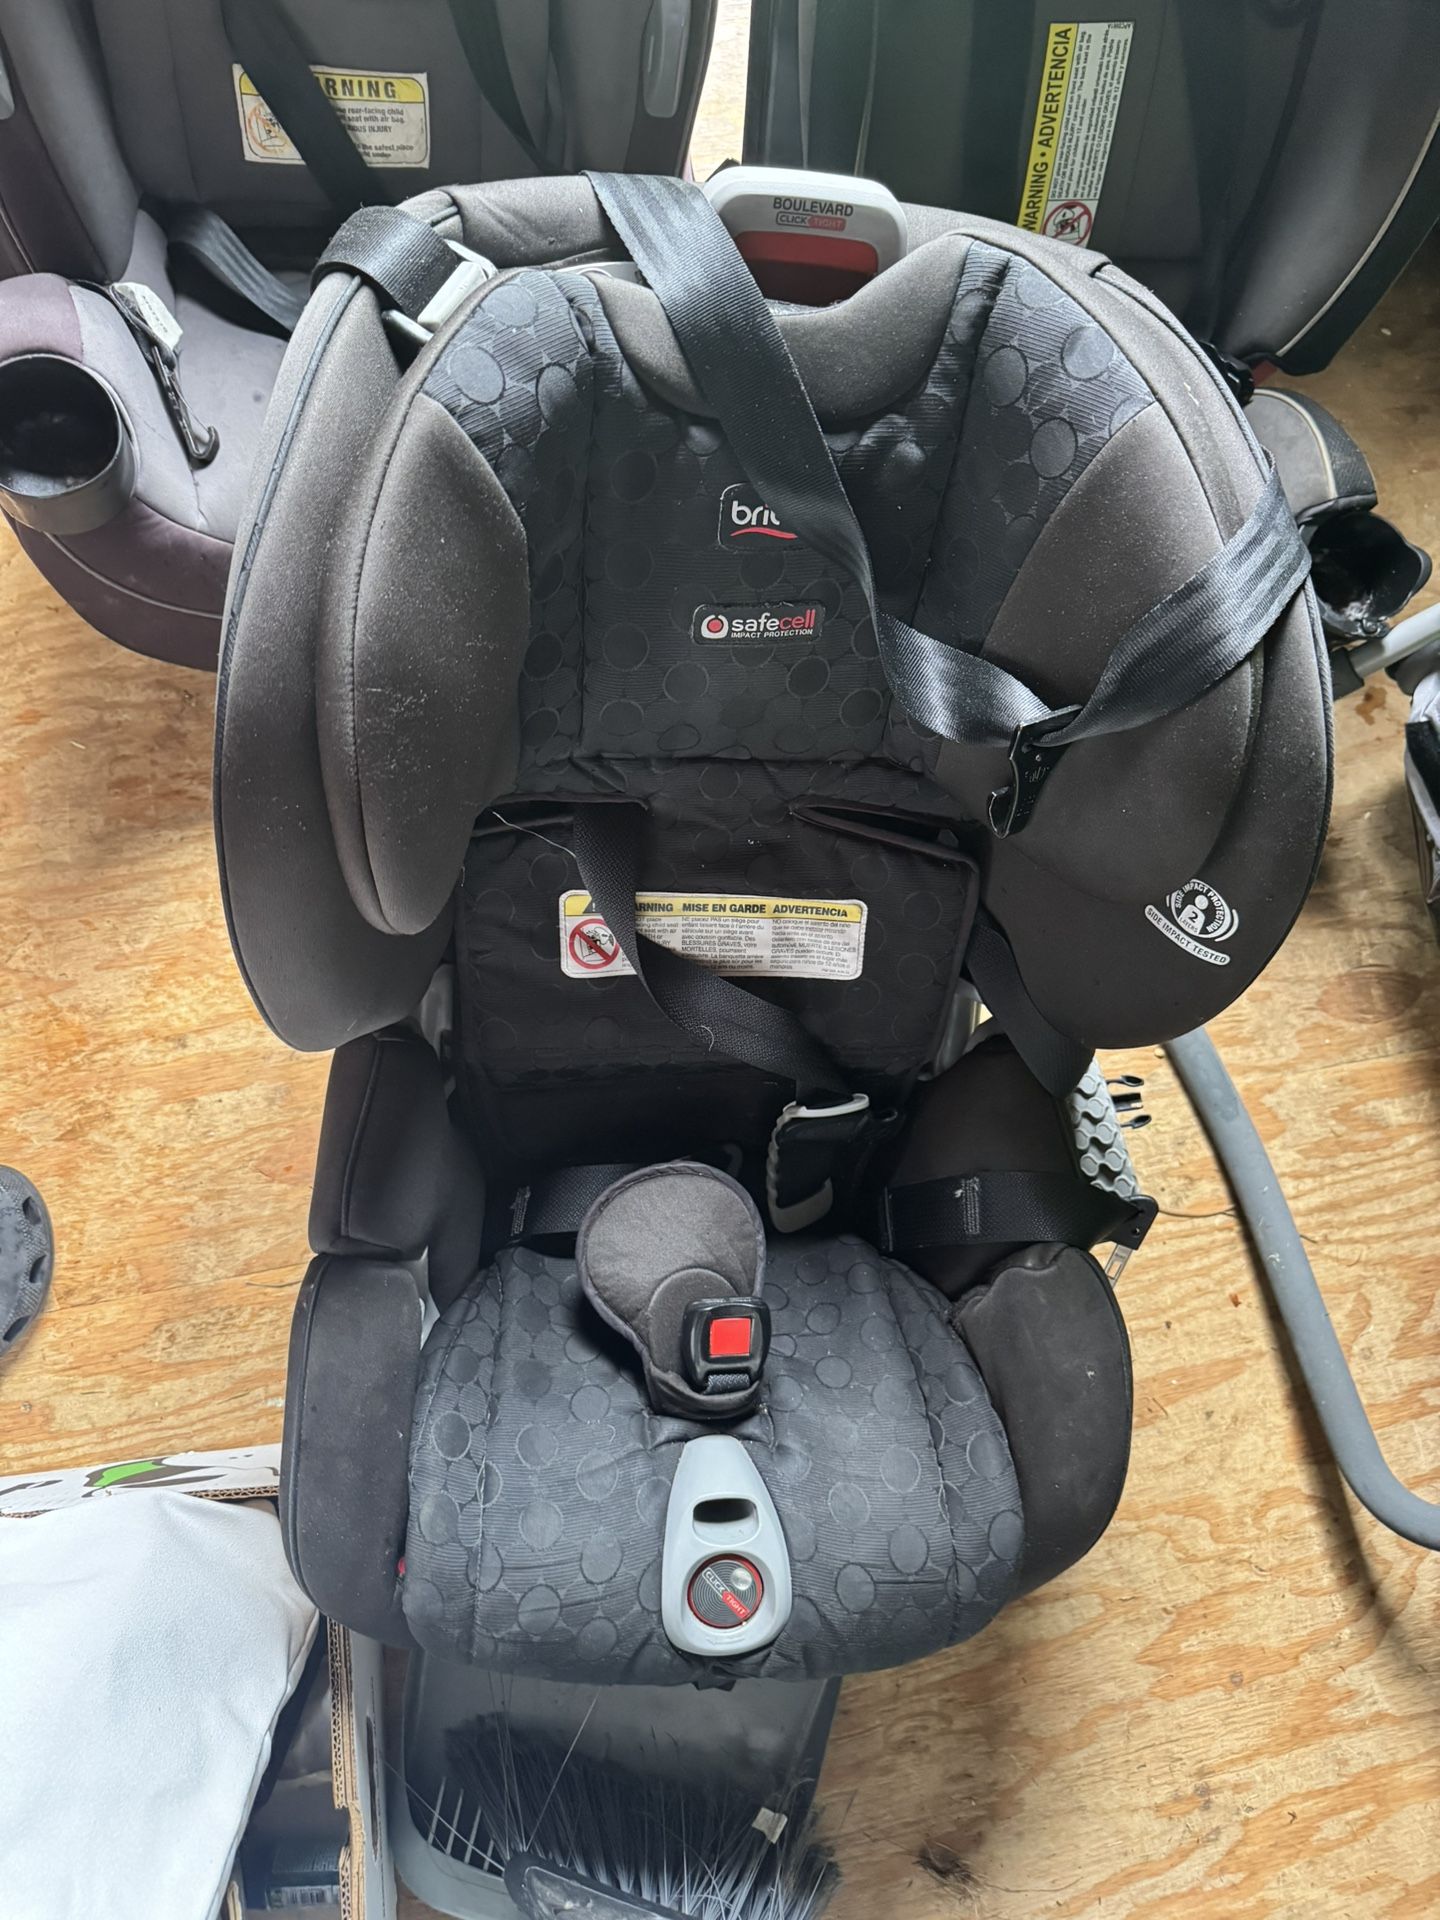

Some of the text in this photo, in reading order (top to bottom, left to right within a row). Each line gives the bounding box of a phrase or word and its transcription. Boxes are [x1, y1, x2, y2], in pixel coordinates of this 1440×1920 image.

[325, 78, 396, 99] RNING
[1022, 27, 1072, 231] WARNING ADVERTENCIA
[773, 197, 854, 217] BOULEVARD
[779, 214, 843, 229] CLICK TIGHT
[731, 608, 816, 632] safecell
[731, 629, 813, 639] IMPACT PROTECTION
[682, 903, 766, 913] MISE EN GARDE
[773, 904, 848, 917] ADVERTENCIA
[1175, 882, 1226, 933] SIDE IMPACT PROTECTION
[1188, 910, 1197, 923] 2
[1146, 907, 1227, 963] SIDE IMPACT TESTED
[1179, 917, 1198, 934] LAYERS
[705, 1570, 746, 1616] CLICK TIGHT
